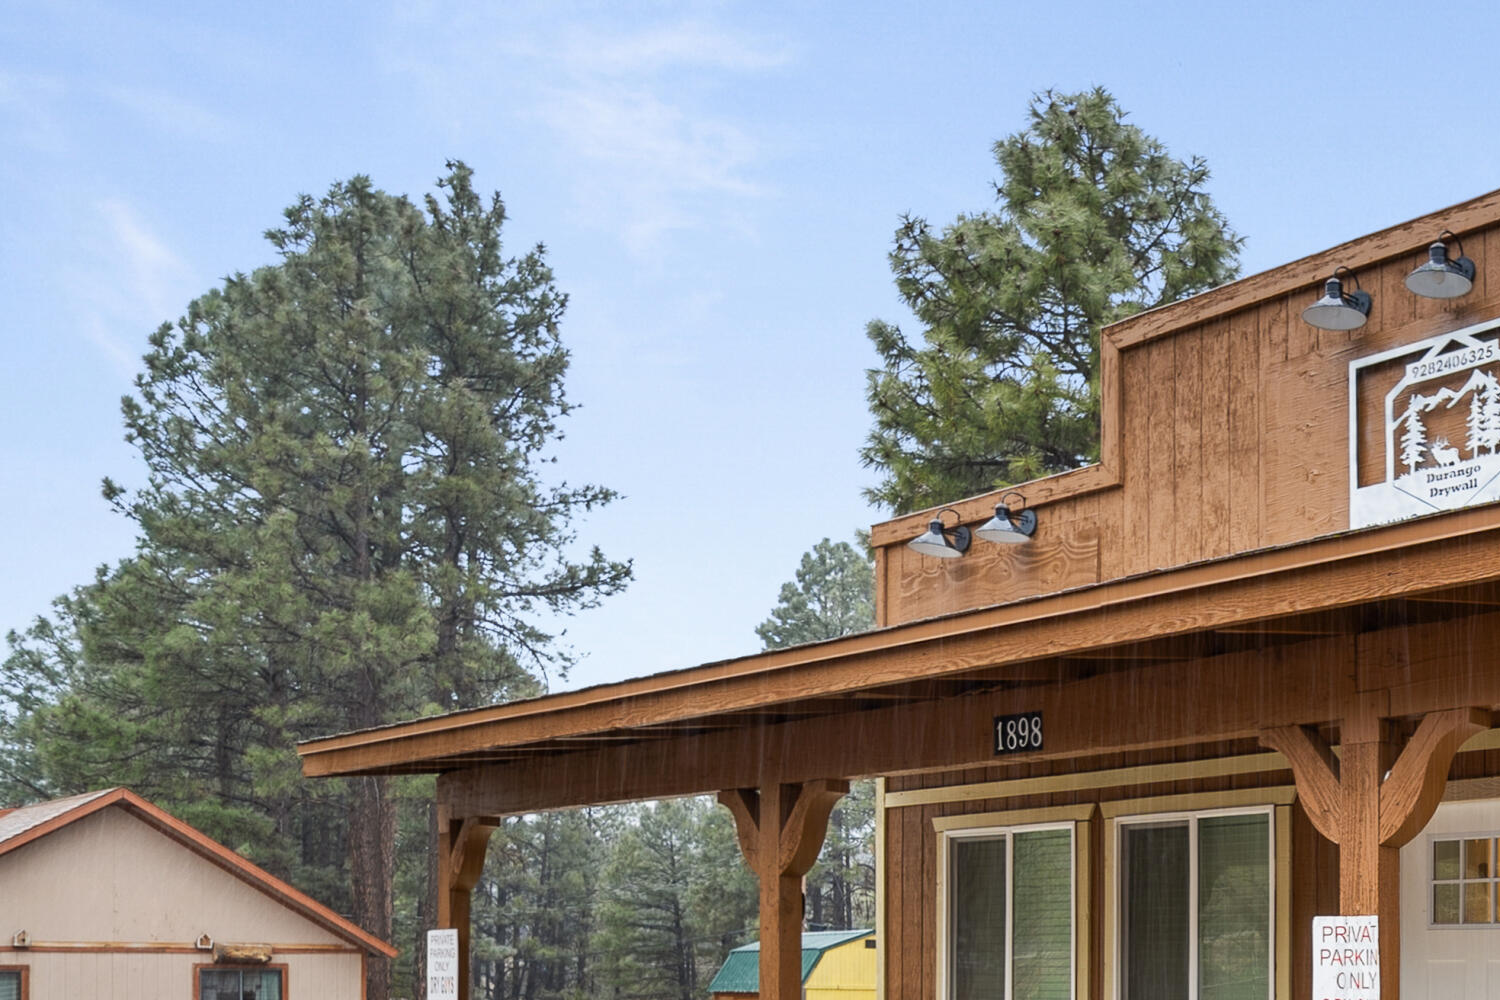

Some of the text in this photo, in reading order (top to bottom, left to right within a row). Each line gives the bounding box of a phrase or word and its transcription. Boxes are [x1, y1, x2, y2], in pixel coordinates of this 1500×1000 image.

[1411, 345, 1494, 379] 9282406325
[1425, 463, 1482, 485] Durango
[1429, 478, 1478, 498] Drywall
[996, 716, 1042, 750] 1898
[430, 934, 455, 946] PRIVATE
[430, 947, 456, 959] PARKING
[1336, 971, 1377, 990] ONLY
